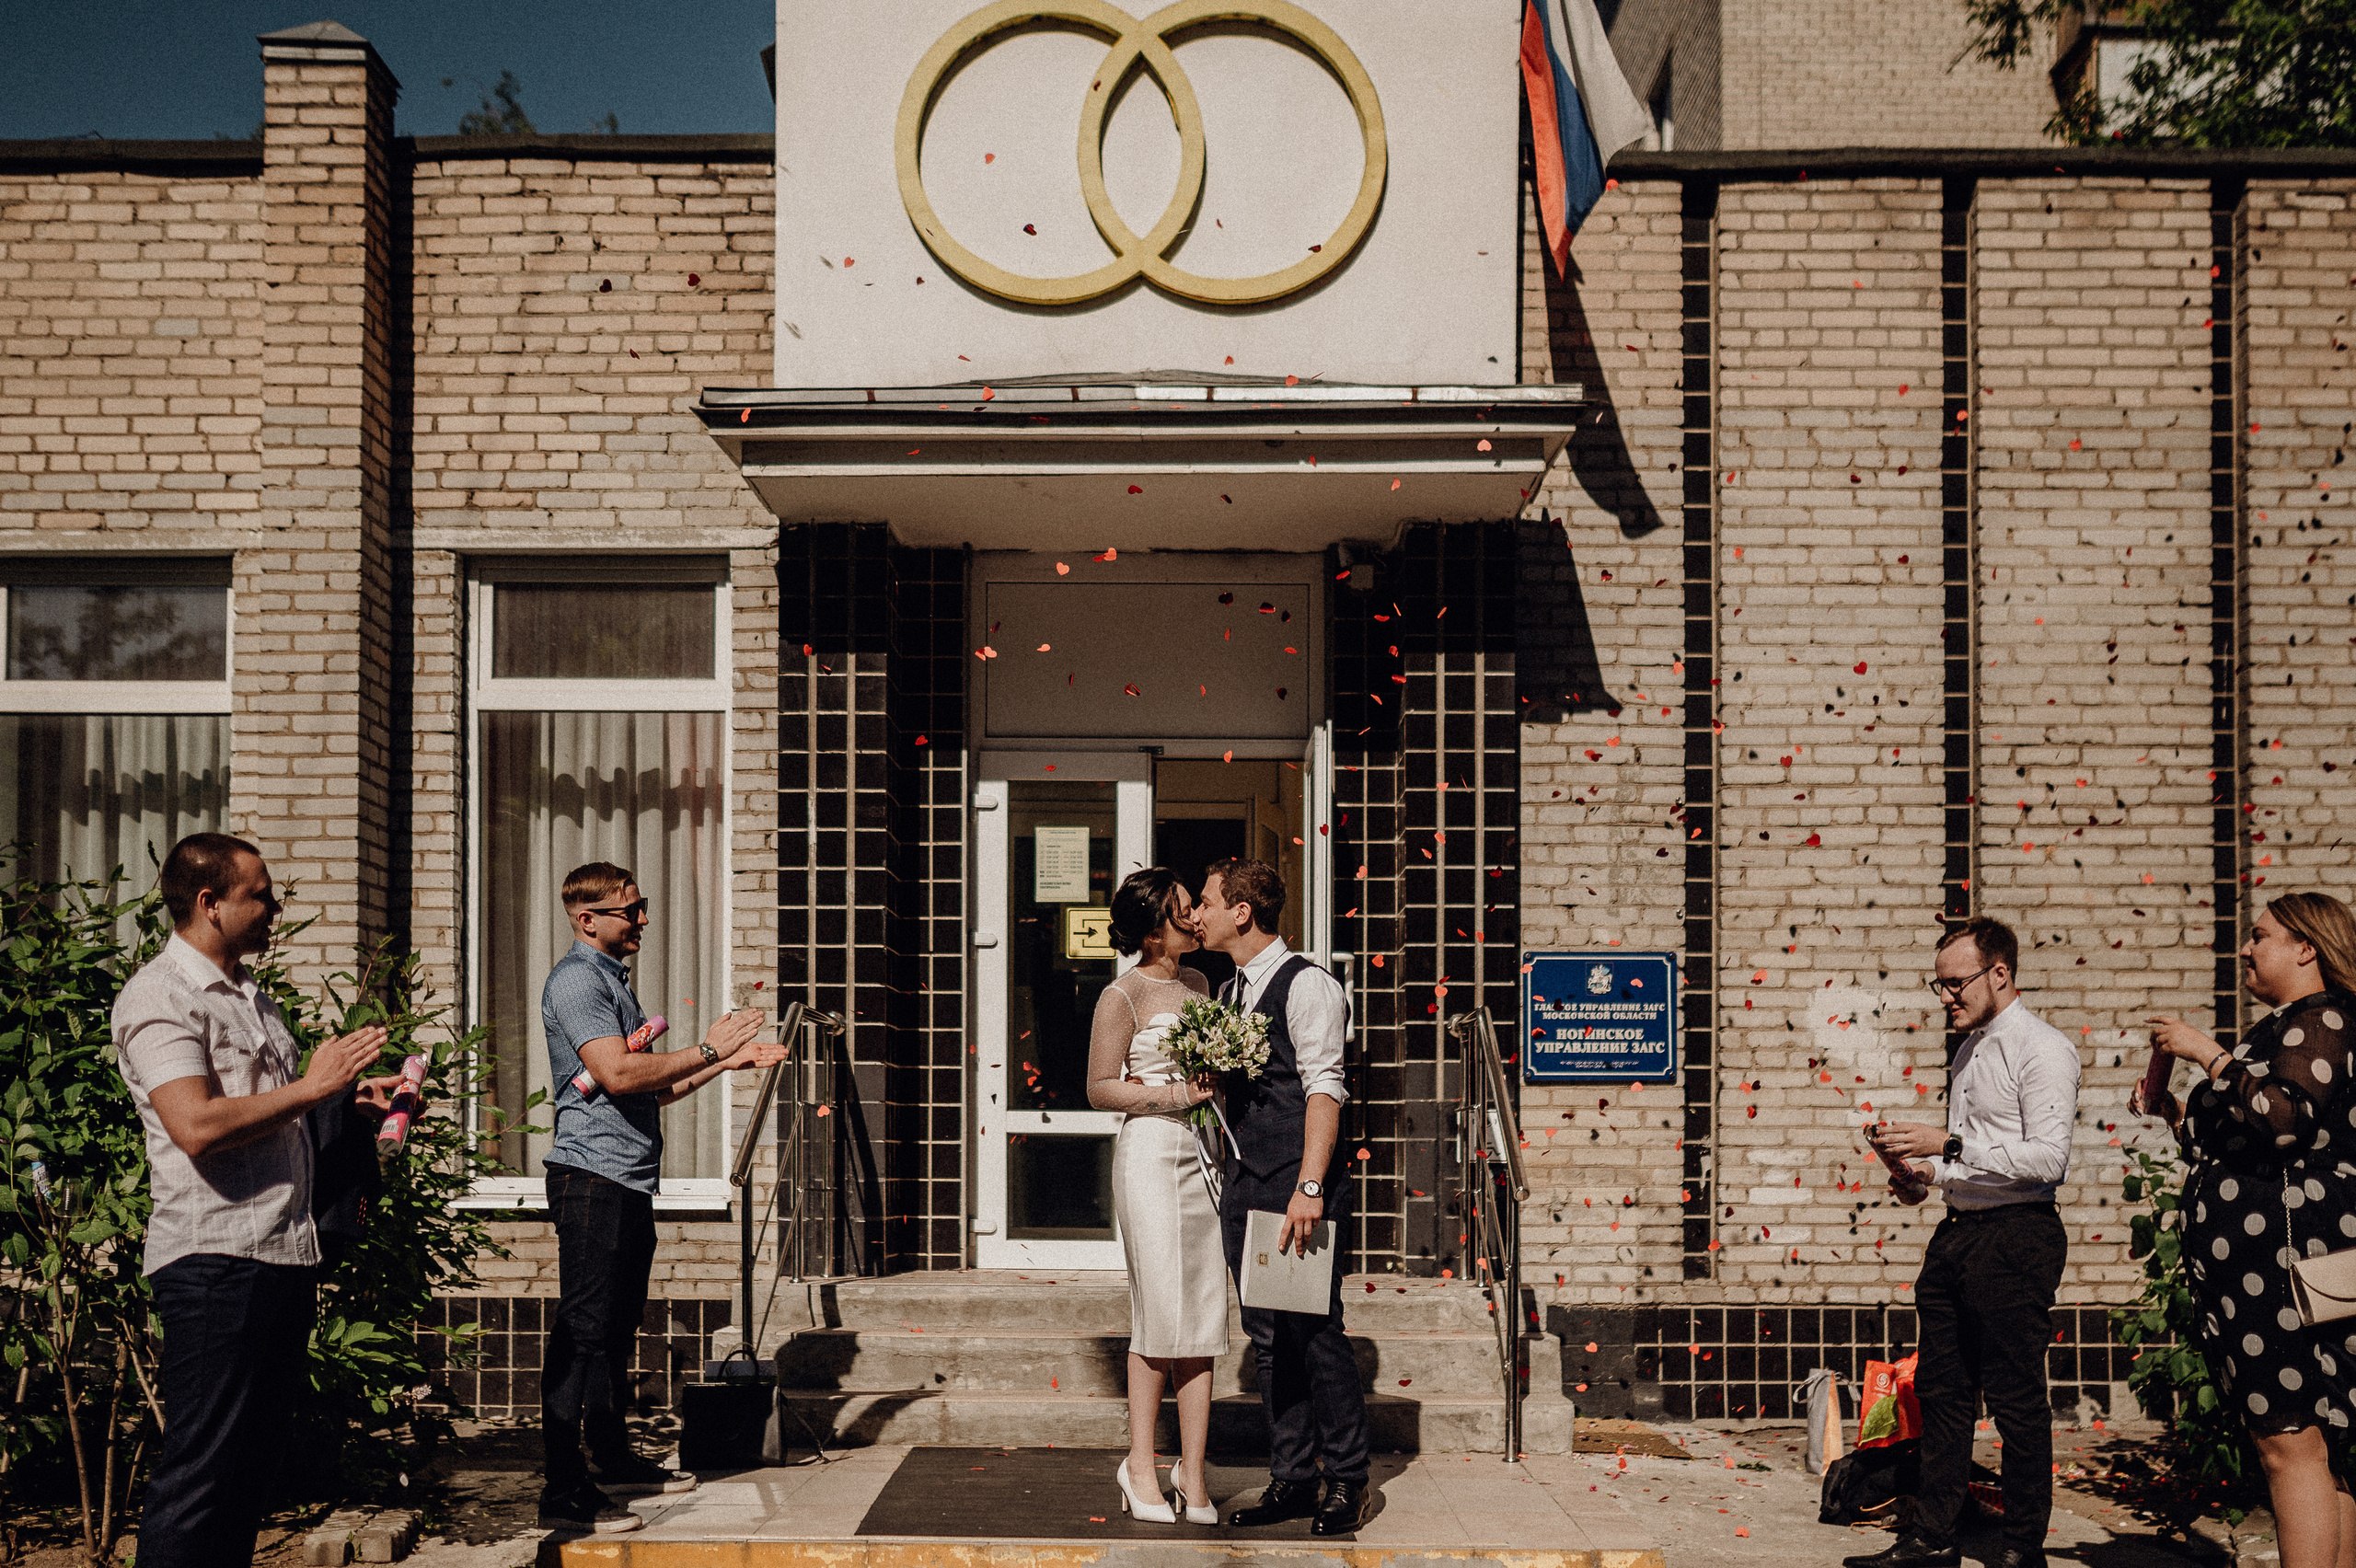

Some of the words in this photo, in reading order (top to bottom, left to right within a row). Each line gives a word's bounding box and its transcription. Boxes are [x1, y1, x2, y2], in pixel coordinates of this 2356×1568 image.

[1534, 1003, 1577, 1011] ГЛАОЕ
[1579, 1003, 1641, 1011] УПРАВЛЕНИЕ
[1643, 1003, 1666, 1011] ЗАГС
[1542, 1011, 1611, 1020] МОСКОВСКОЙ
[1612, 1011, 1657, 1020] ОБЛАСТИ
[1534, 1042, 1629, 1054] УПРАВЛЕНИЕ
[1631, 1042, 1666, 1054] ЗАГС
